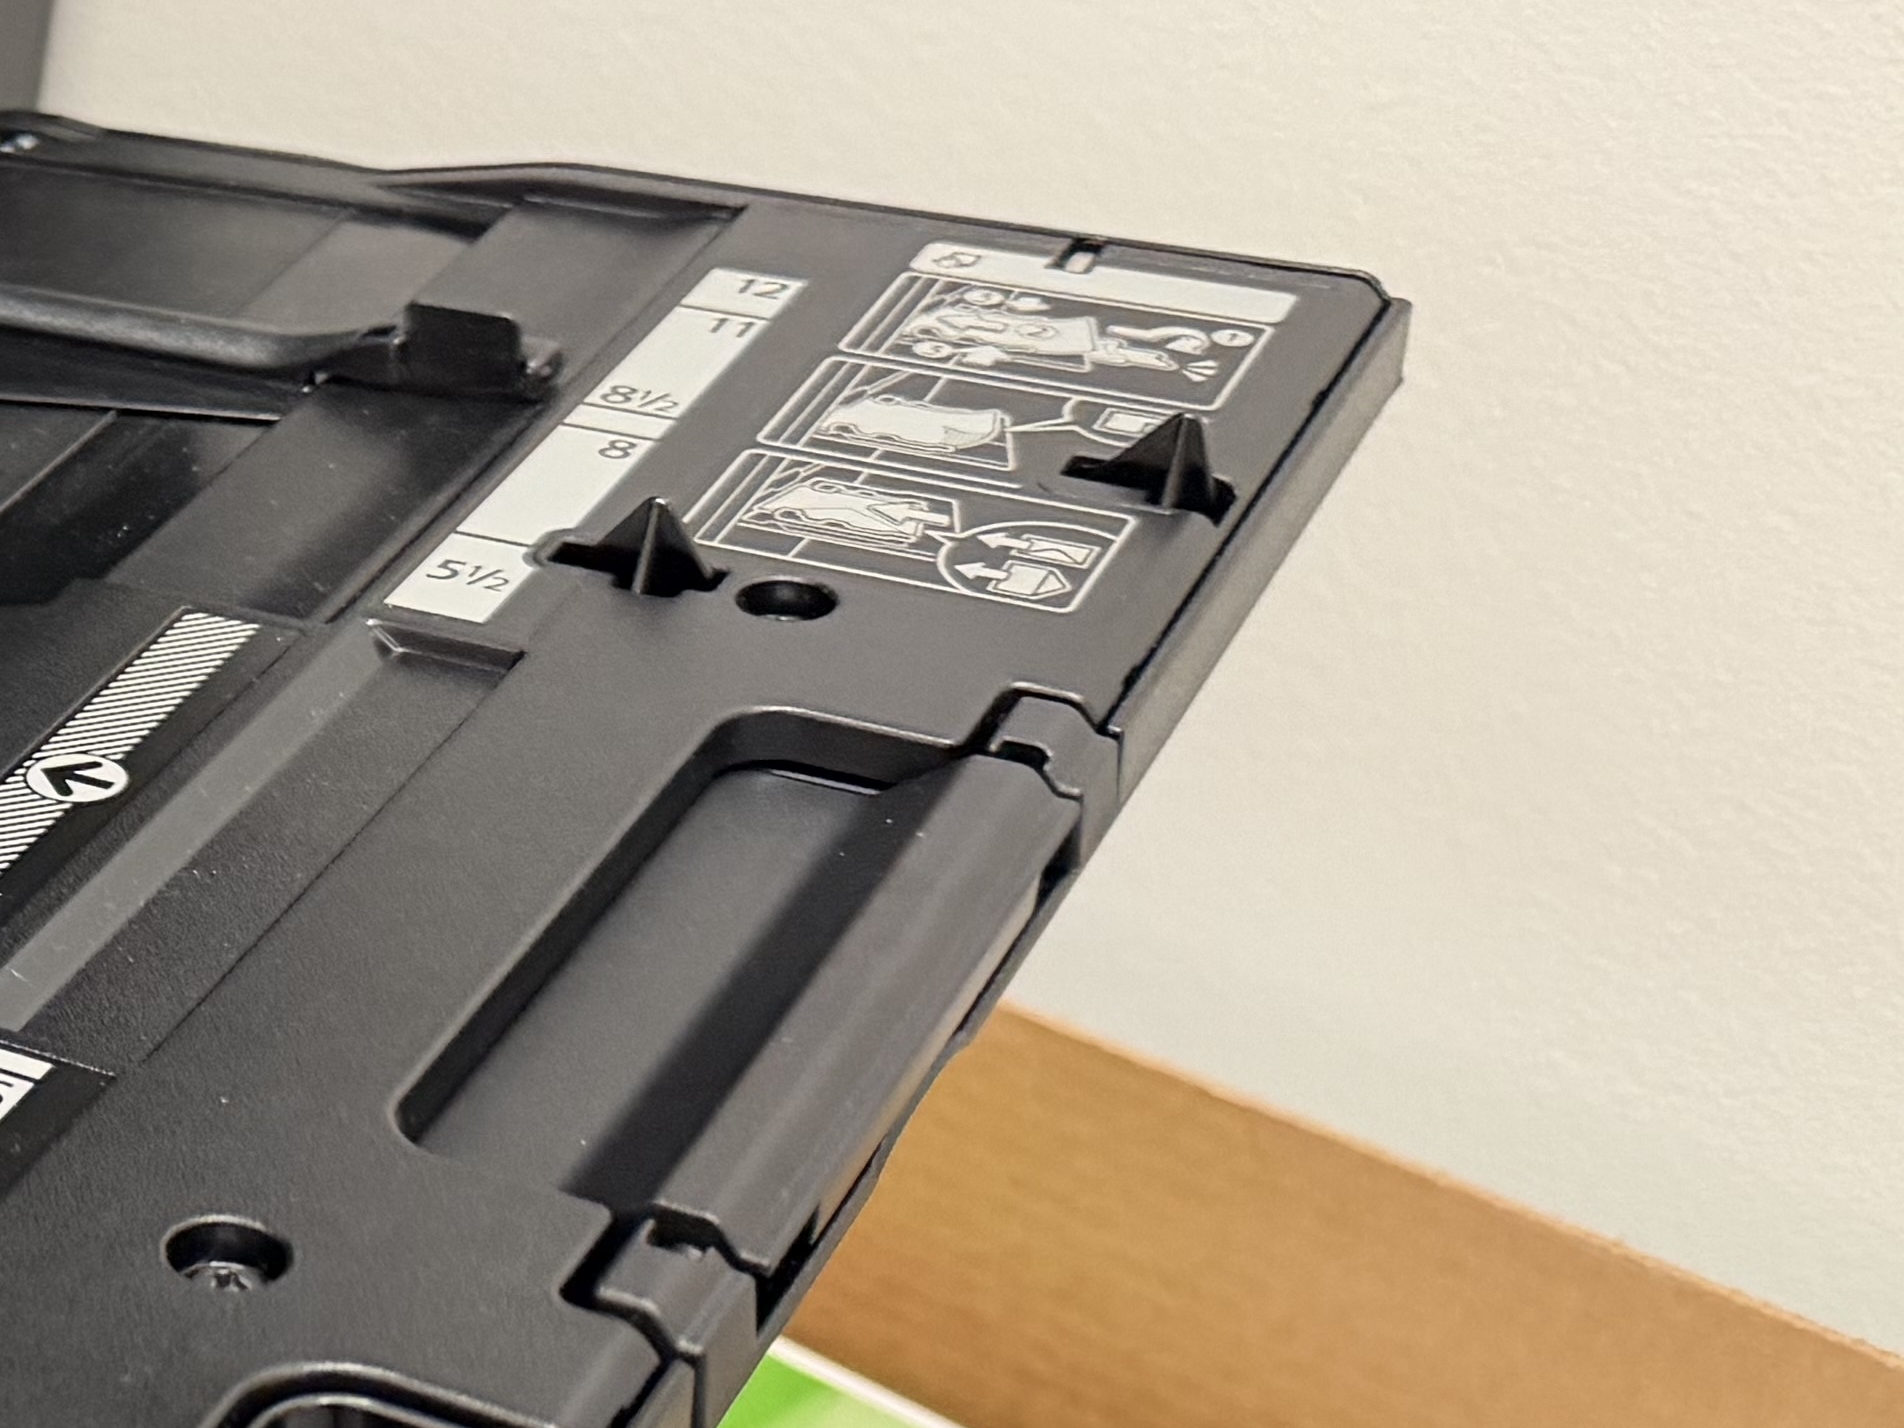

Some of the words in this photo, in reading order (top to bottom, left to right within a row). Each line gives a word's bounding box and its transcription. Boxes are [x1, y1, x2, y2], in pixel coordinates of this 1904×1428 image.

[736, 278, 790, 300] 12
[708, 317, 759, 338] 11
[598, 439, 637, 459] 8
